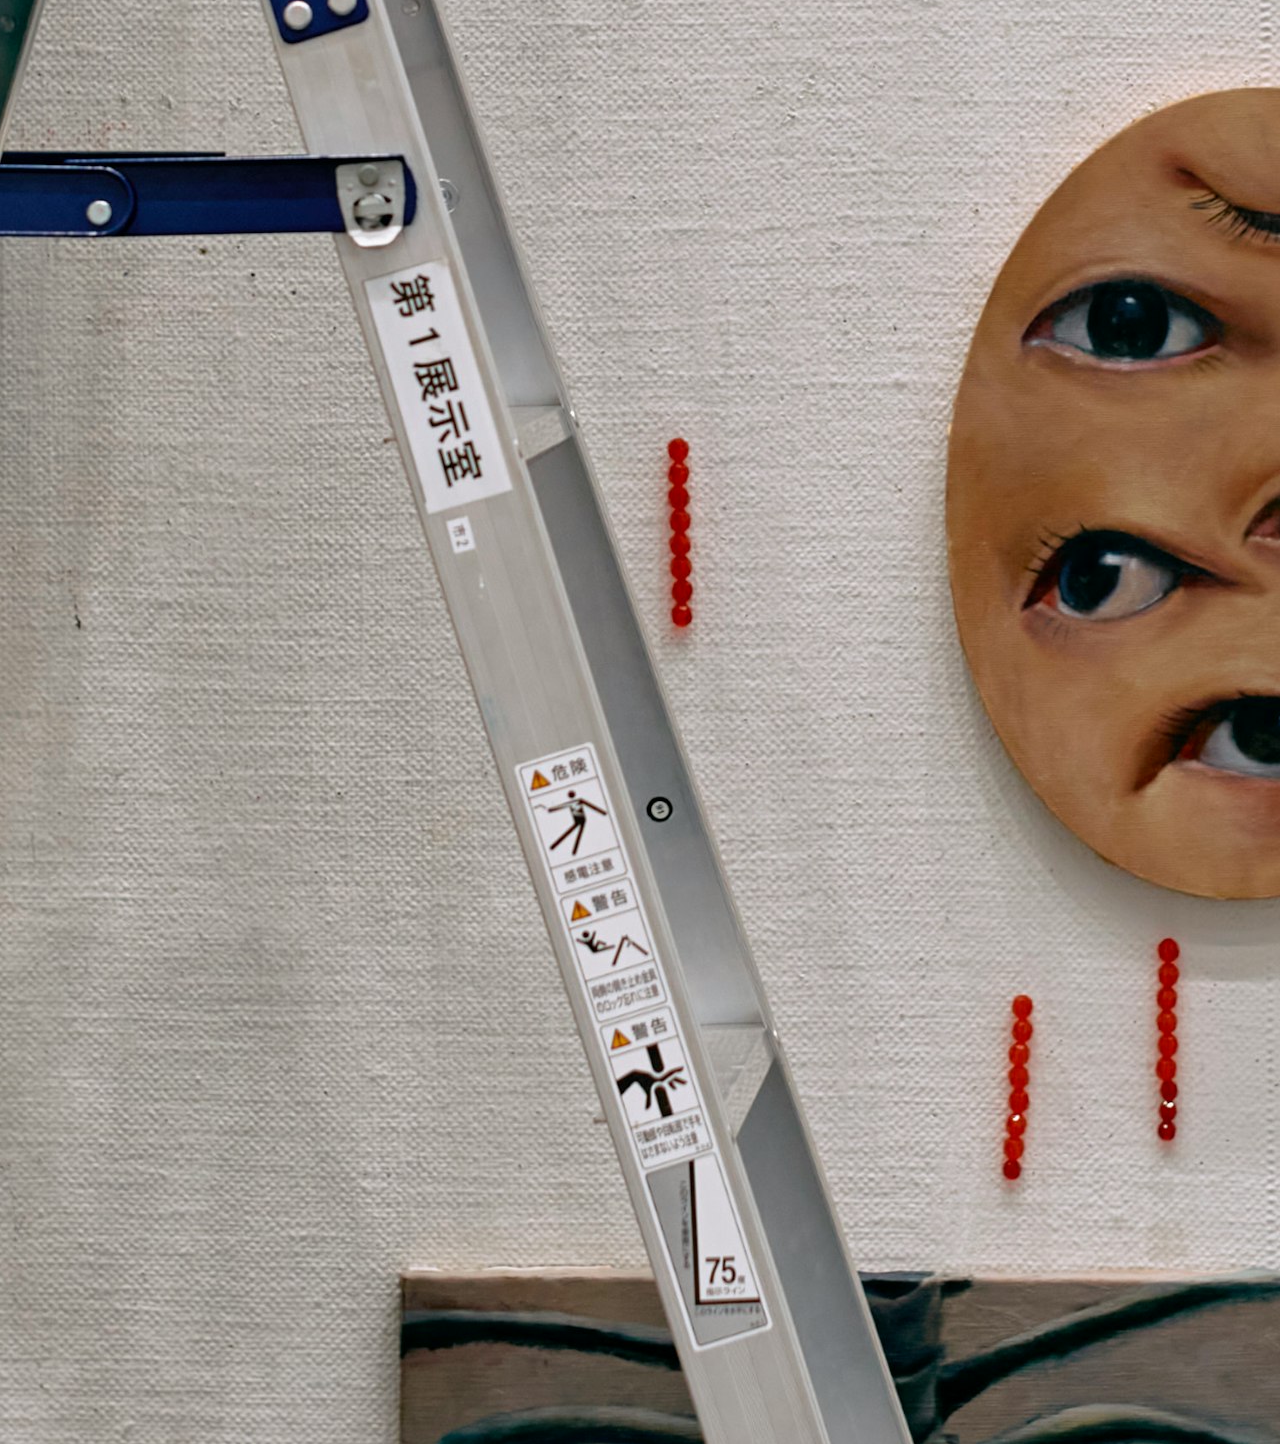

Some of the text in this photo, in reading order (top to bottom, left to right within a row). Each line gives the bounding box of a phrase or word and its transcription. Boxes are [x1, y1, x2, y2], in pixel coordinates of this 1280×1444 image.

[552, 757, 588, 782] 危険
[591, 888, 627, 913] 警告
[631, 1016, 668, 1041] 警告
